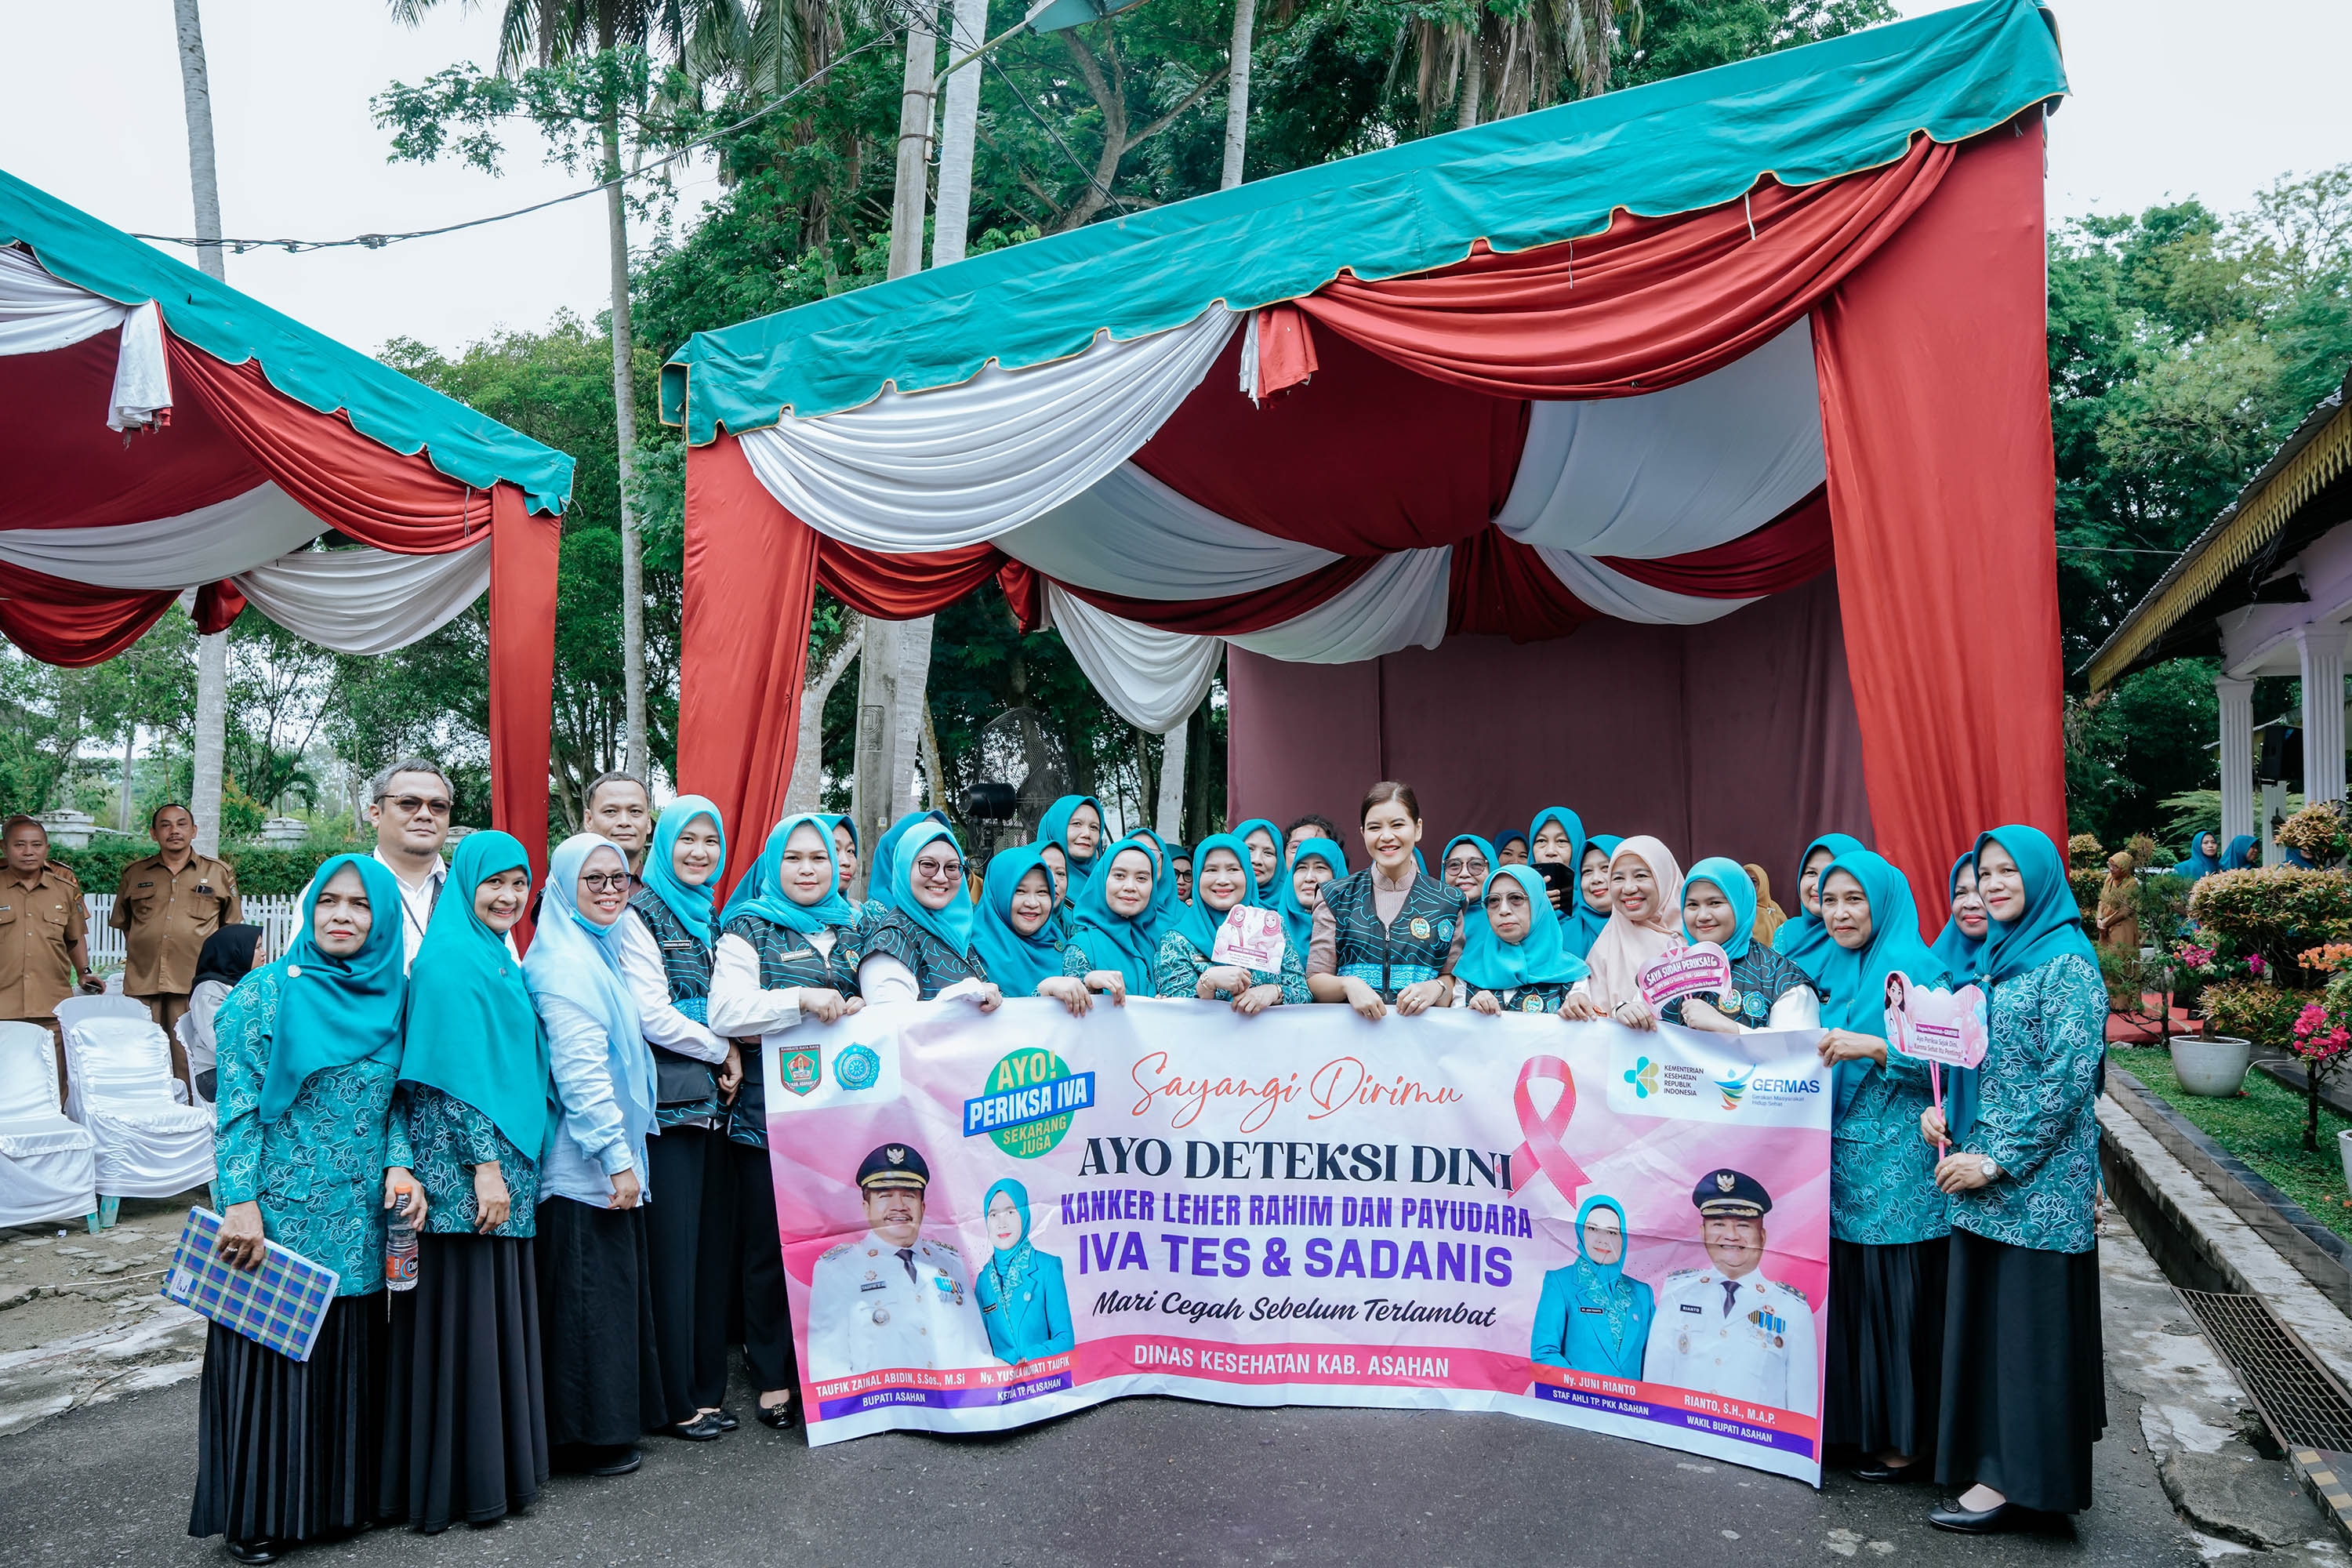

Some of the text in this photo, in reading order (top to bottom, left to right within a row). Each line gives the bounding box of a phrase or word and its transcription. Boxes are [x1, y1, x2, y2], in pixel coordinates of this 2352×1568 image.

[1646, 956, 1711, 985] SAYA SUDAH PERIKSA!
[997, 1051, 1057, 1091] AYO!
[1664, 1065, 1704, 1074] KEMENTERIAN
[1664, 1073, 1697, 1081] KESEHATAN
[1131, 1051, 1463, 1133] Sayangi Dirimu
[1752, 1079, 1820, 1094] GERMAS
[969, 1077, 1087, 1131] PERIKSA IVA
[1003, 1116, 1066, 1145] SEKARANG
[1019, 1135, 1051, 1156] JUGA
[1077, 1137, 1513, 1192] AYO DETEKSI DINI
[1062, 1189, 1533, 1239] KANKER LEHER RAHIM DAN PAYUDARA
[1080, 1231, 1512, 1287] IVA TES & SADANIS
[1093, 1290, 1497, 1327] Mari Cegah Sebelum Terlambat
[980, 1372, 994, 1385] Ny.
[1047, 1356, 1069, 1371] TAUFIK
[1134, 1345, 1449, 1377] DINAS KESEHATAN KAB. ASAHAN
[815, 1374, 966, 1397] TAUFIK ZAINAL ABIDIN, S.Sos., M.Si
[862, 1392, 925, 1406] BUPATI ASAHAN
[1036, 1378, 1062, 1392] ASAHAN
[1563, 1373, 1635, 1396] Ny. JUNI RIANTO
[1552, 1389, 1649, 1416] STAF AHLI TP. PKK ASAHAN
[1684, 1394, 1776, 1425] RIANTO, S.H., M.A.P.
[1687, 1415, 1772, 1443] WAKIL BUPATI ASAHAN
